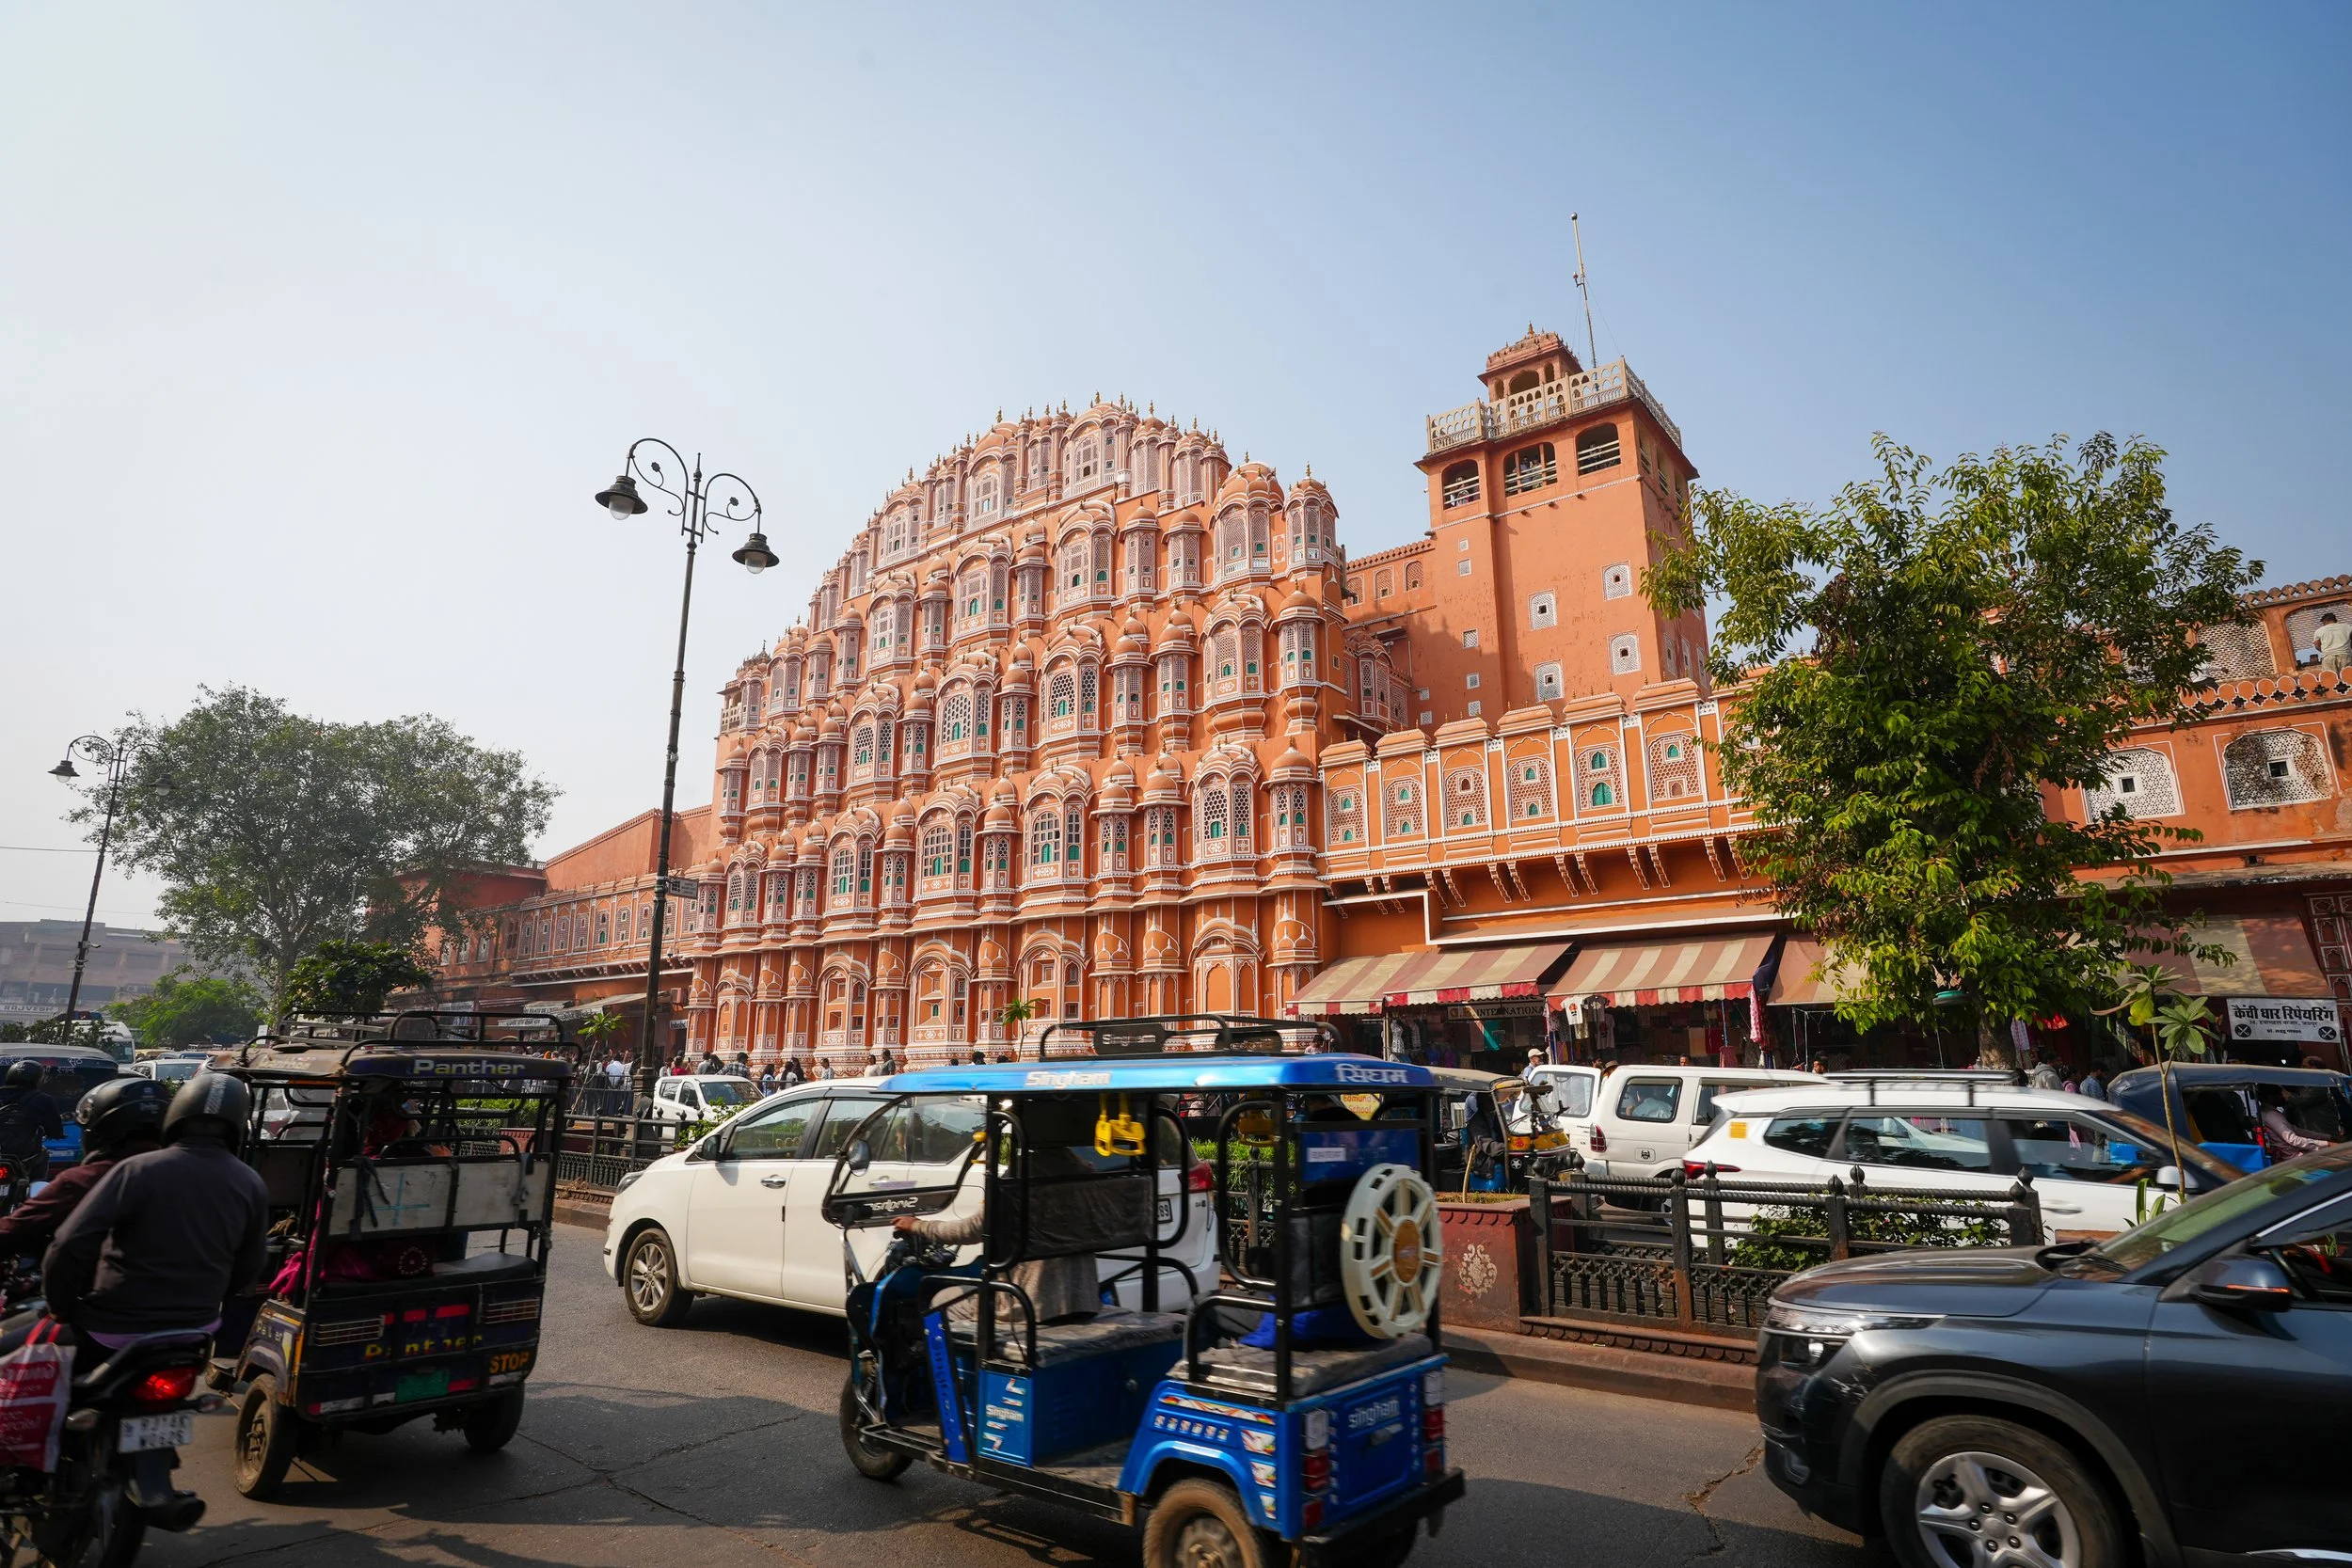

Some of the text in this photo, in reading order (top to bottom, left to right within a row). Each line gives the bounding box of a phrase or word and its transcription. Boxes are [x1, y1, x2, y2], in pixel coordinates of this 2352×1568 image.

[1476, 1006, 1544, 1017] INTENATIONA
[2232, 1004, 2334, 1022] कैंची धार रिपेयरिंग
[1102, 1034, 1156, 1047] Singham
[413, 1059, 526, 1075] Panther
[1334, 1063, 1409, 1084] सिंघम
[1025, 1070, 1114, 1089] Singham
[1157, 1204, 1169, 1217] 89
[489, 1351, 531, 1373] STOP
[986, 1404, 1025, 1423] Singham
[1348, 1398, 1400, 1430] singham
